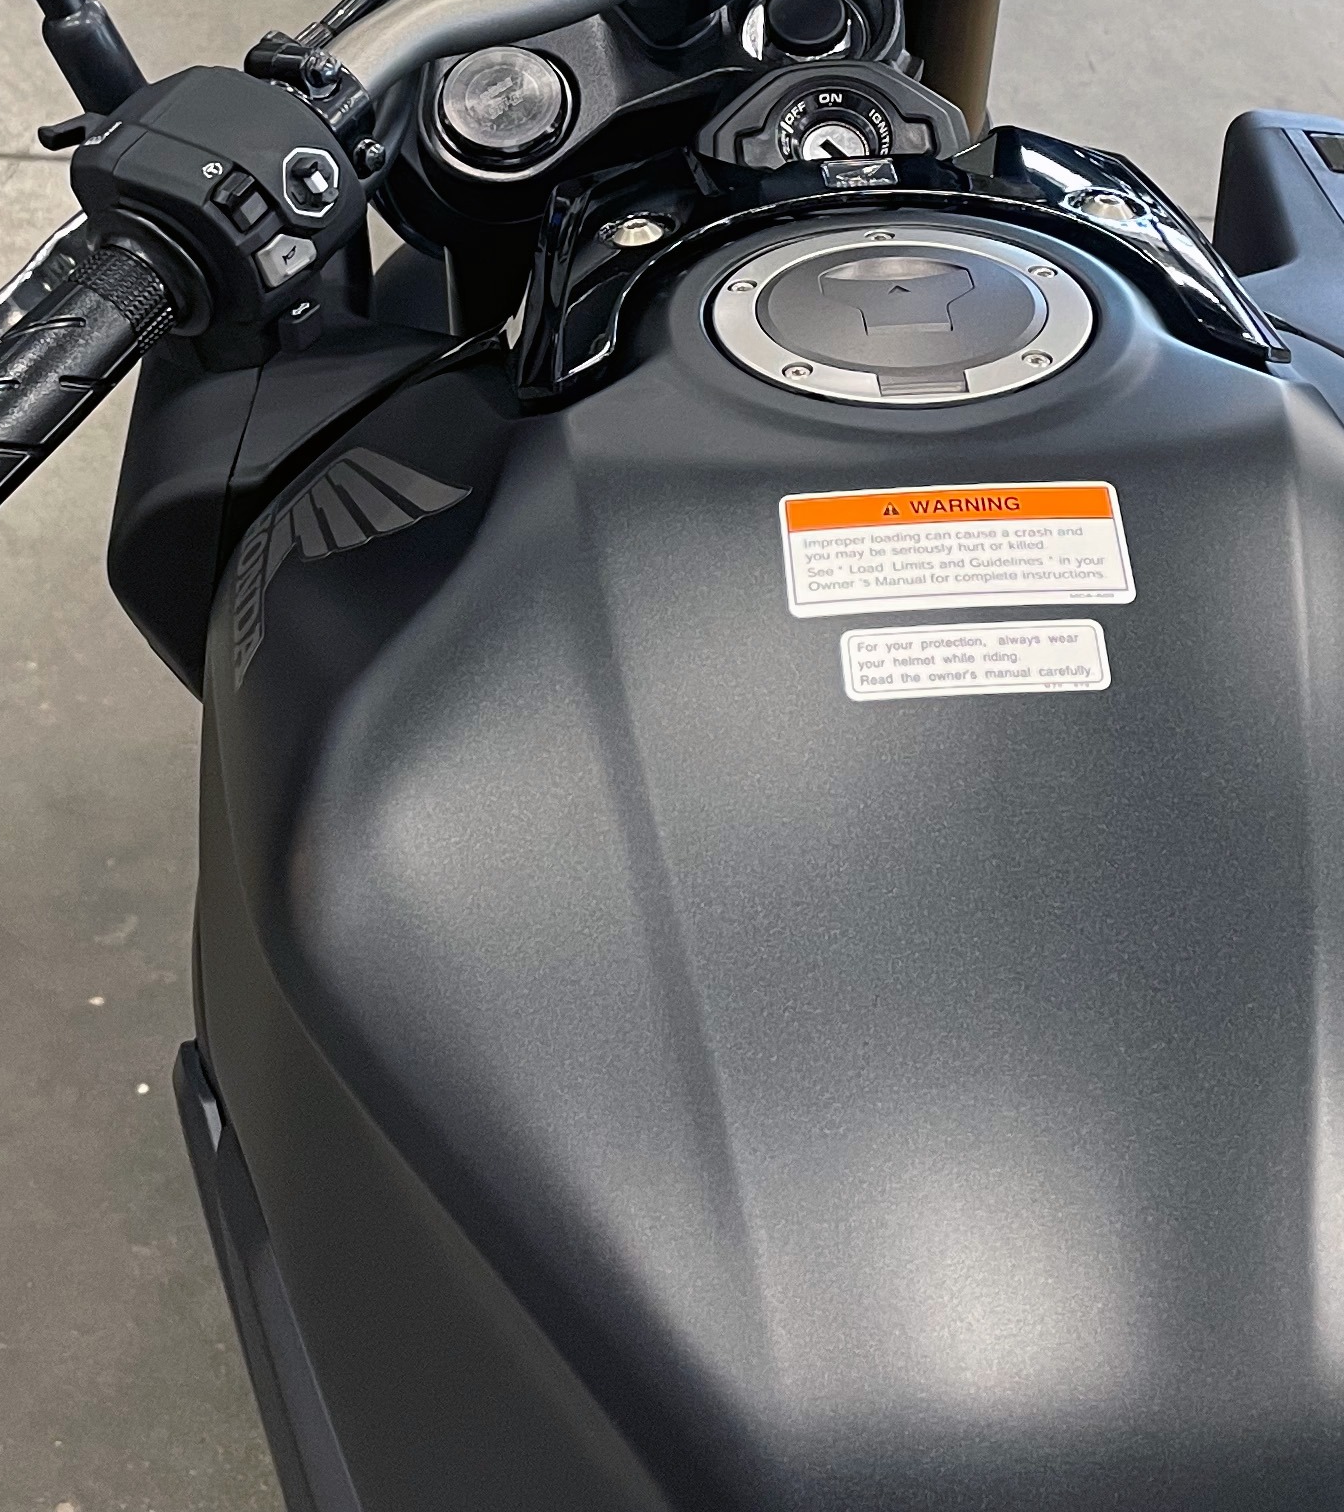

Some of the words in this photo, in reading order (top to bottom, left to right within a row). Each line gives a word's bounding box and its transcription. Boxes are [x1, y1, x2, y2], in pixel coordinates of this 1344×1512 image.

[818, 93, 843, 104] ON
[784, 100, 806, 125] OFF
[909, 496, 1020, 514] WARNING
[803, 536, 866, 550] Improper
[870, 532, 921, 545] loading
[925, 531, 952, 542] can
[955, 528, 997, 539] cause
[1001, 527, 1010, 538] a
[1014, 527, 1053, 538] crash
[1057, 527, 1084, 537] and
[805, 551, 831, 565] you
[835, 548, 865, 560] may
[869, 547, 887, 557] be
[891, 543, 953, 556] seriously
[958, 541, 985, 552] hurt
[989, 542, 1003, 551] or
[807, 567, 834, 578] See
[892, 561, 934, 572] Limits
[939, 558, 965, 569] and
[969, 556, 1044, 568] Guidelines
[1058, 555, 1071, 565] in
[1075, 555, 1106, 568] your
[875, 573, 927, 587] Manual
[930, 574, 950, 584] for
[955, 571, 1018, 584] complete
[233, 511, 272, 672] HONDA
[857, 642, 878, 652] For
[885, 641, 913, 653] your
[920, 637, 987, 651] protection,
[998, 634, 1041, 647] always
[1047, 634, 1079, 644] wear
[858, 659, 886, 671] your
[892, 655, 936, 667] helmet
[942, 652, 976, 664] while
[860, 673, 894, 686] Read
[900, 673, 921, 683] the
[928, 669, 978, 682] owner's
[984, 667, 1031, 679] manual
